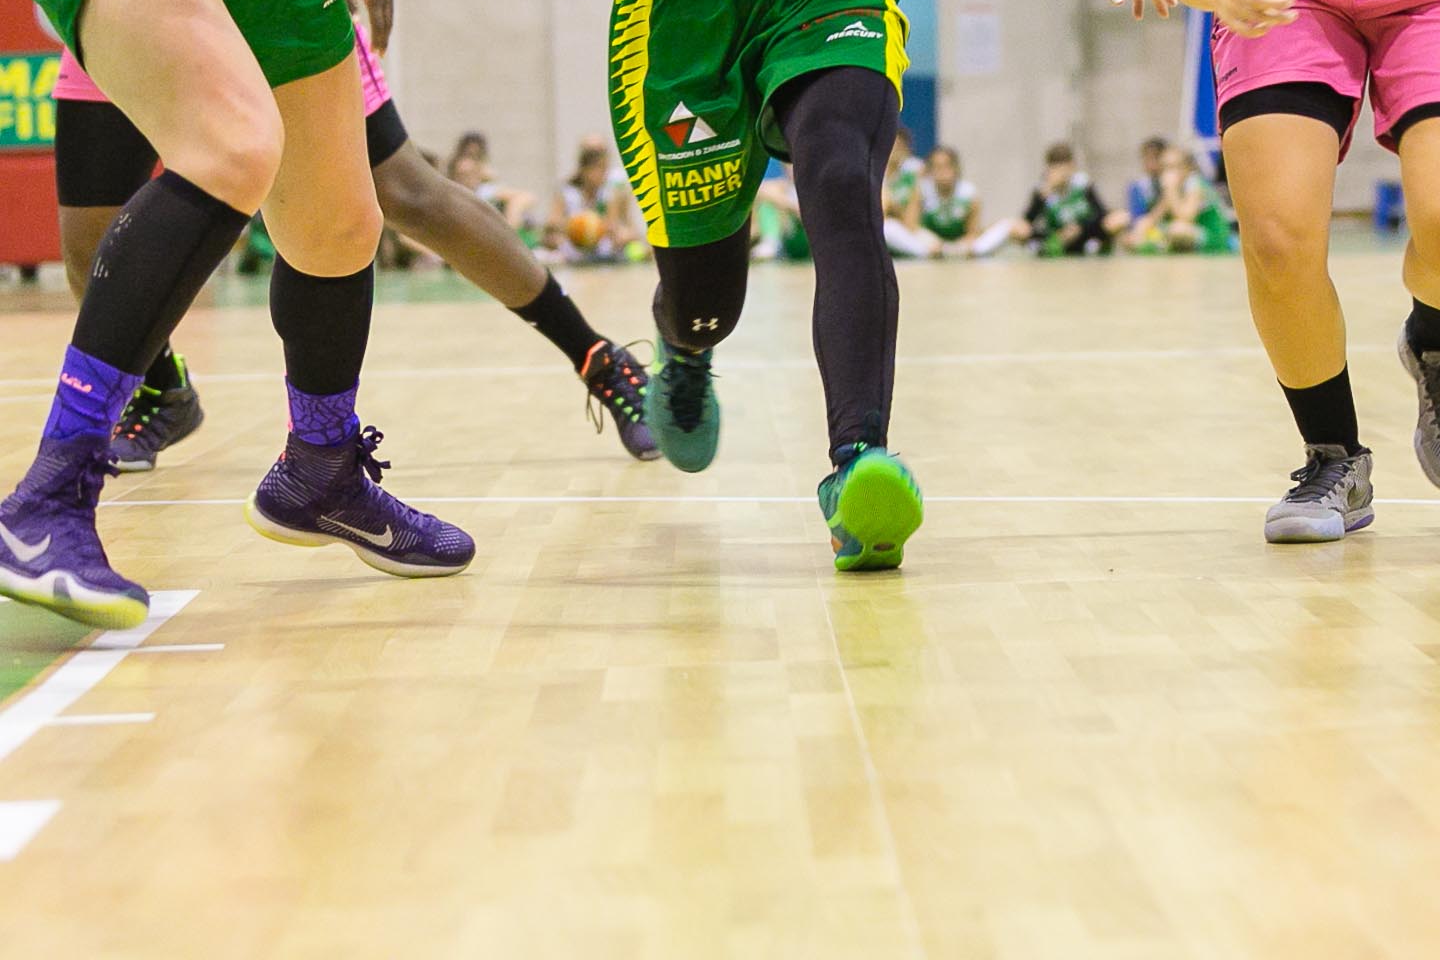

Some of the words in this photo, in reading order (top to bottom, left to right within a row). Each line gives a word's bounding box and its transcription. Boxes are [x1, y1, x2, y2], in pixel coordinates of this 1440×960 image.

[826, 30, 883, 42] MERCURY
[665, 158, 741, 189] MANN
[667, 173, 742, 208] FILTER
